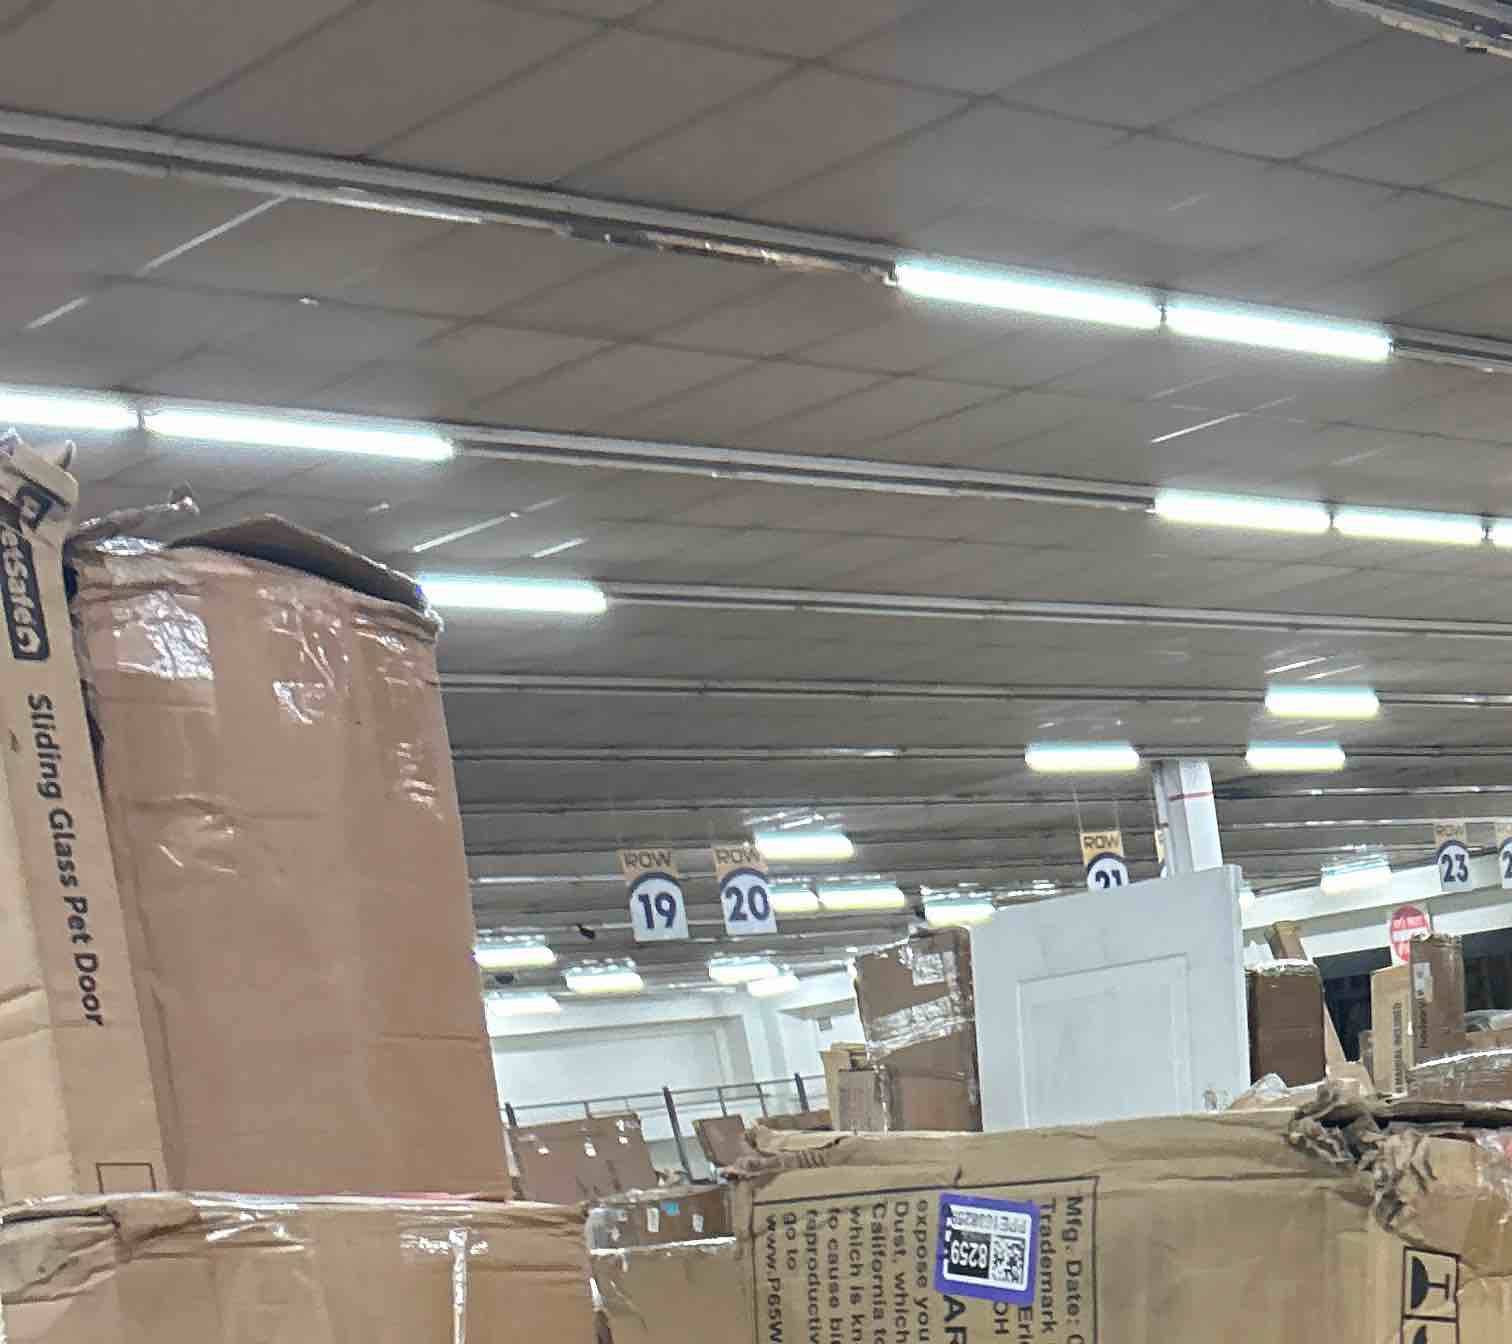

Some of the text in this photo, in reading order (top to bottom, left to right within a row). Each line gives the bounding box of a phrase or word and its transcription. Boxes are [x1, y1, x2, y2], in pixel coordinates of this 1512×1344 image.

[28, 695, 105, 1028] Sliding Glass Pet Door
[624, 851, 671, 867] ROW
[715, 849, 760, 864] ROW
[1084, 834, 1118, 848] ROW
[1441, 854, 1468, 882] 23
[638, 892, 676, 928] 19
[726, 885, 769, 921] 20
[783, 1212, 798, 1271] go to
[827, 1207, 841, 1230] to
[849, 1205, 864, 1276] which
[892, 1201, 909, 1264] Dust,
[914, 1199, 929, 1288] expose
[1062, 1196, 1082, 1250] Mfg.
[827, 1238, 842, 1308] cause
[871, 1203, 887, 1320] California
[951, 1240, 988, 1268] 8259
[1040, 1198, 1057, 1334] Trademark
[850, 1286, 863, 1305] is
[894, 1272, 910, 1344] which
[914, 1297, 929, 1341] you
[1066, 1260, 1085, 1325] Date:
